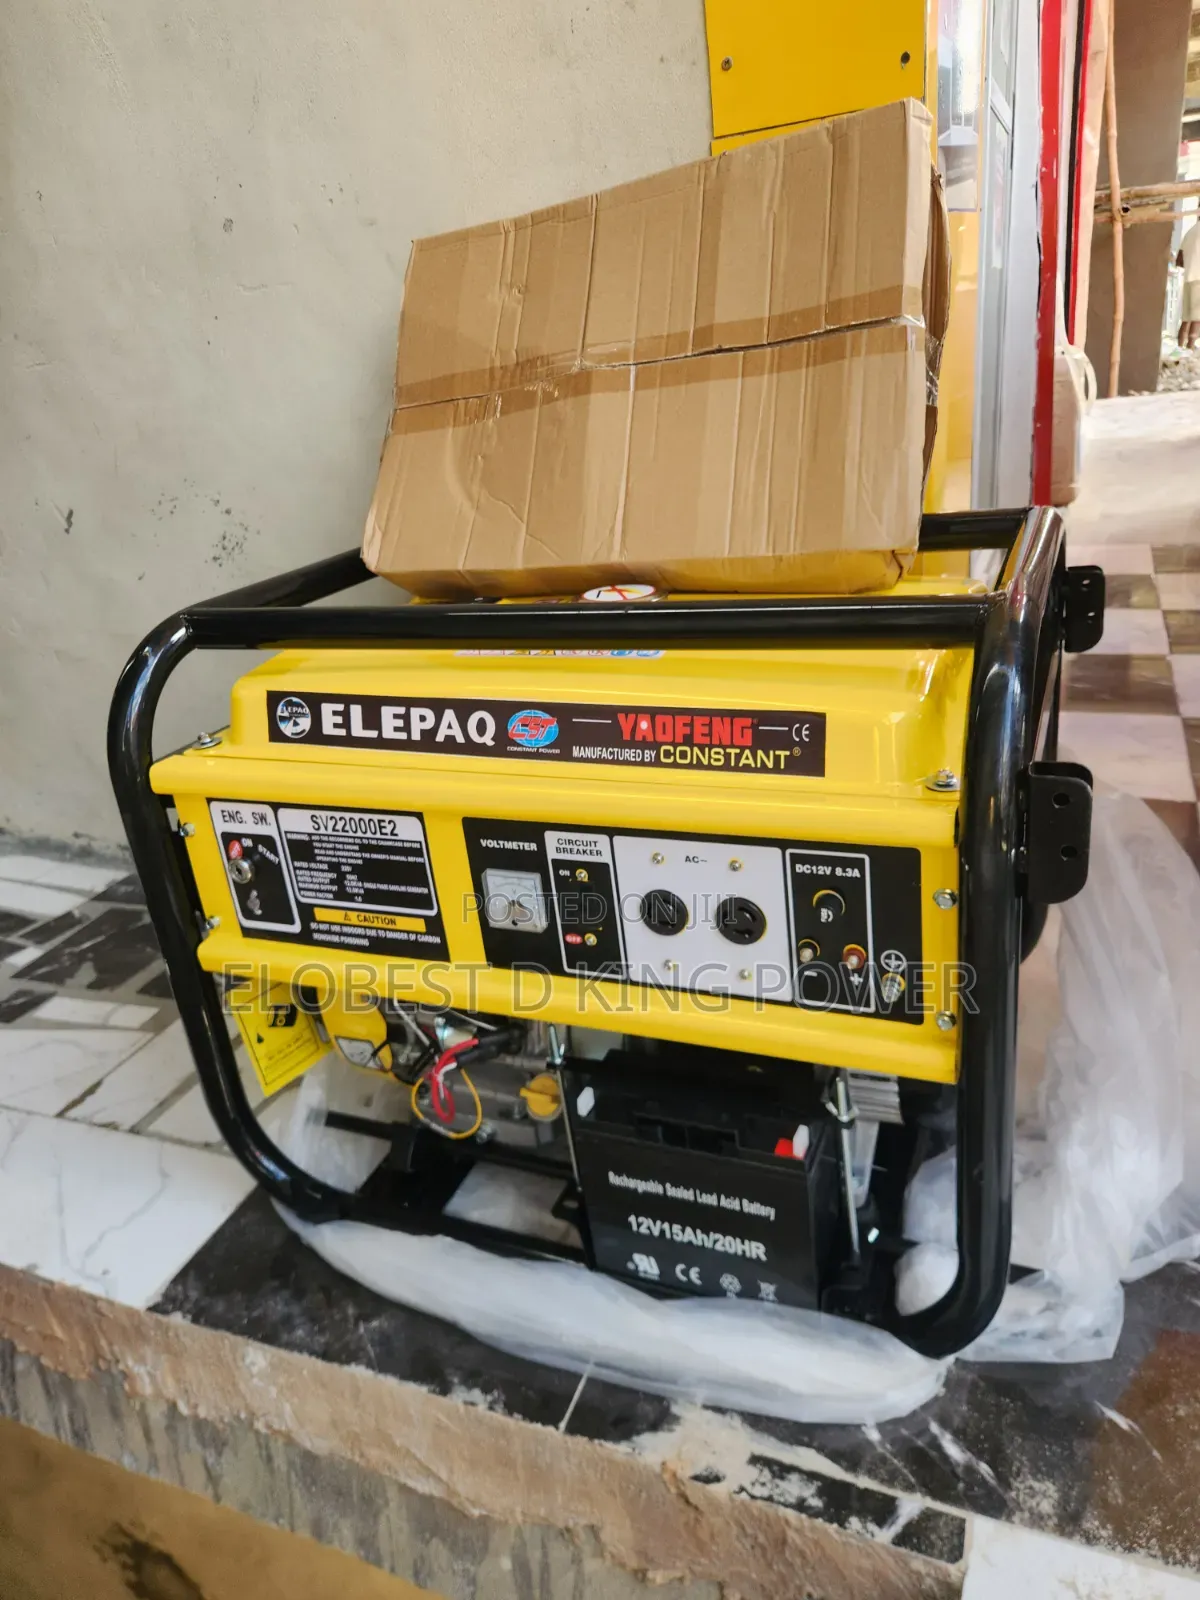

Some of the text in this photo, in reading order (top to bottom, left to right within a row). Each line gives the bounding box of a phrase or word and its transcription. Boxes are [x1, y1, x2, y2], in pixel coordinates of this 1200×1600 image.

[320, 702, 496, 746] ELEPAQ
[508, 715, 557, 740] CST
[617, 712, 753, 746] YAOFENG
[572, 744, 643, 761] MANUFACTURED
[643, 750, 657, 763] BY
[221, 809, 272, 827] ENG. SW.
[310, 814, 399, 837] SV22000E2
[480, 838, 538, 851] VOLTMETER
[555, 846, 603, 857] BREAKER
[556, 837, 599, 848] CIRCUIT
[258, 844, 280, 865] START
[558, 869, 571, 877] ON
[795, 863, 861, 878] DC12V 8.3A
[356, 914, 397, 926] CAUTION
[386, 931, 409, 940] DANGER
[417, 934, 441, 944] CARBON
[607, 1171, 776, 1222] Rechargeable Sealed Lead Acid Battery
[628, 1214, 768, 1263] 12V15Ah/20HR
